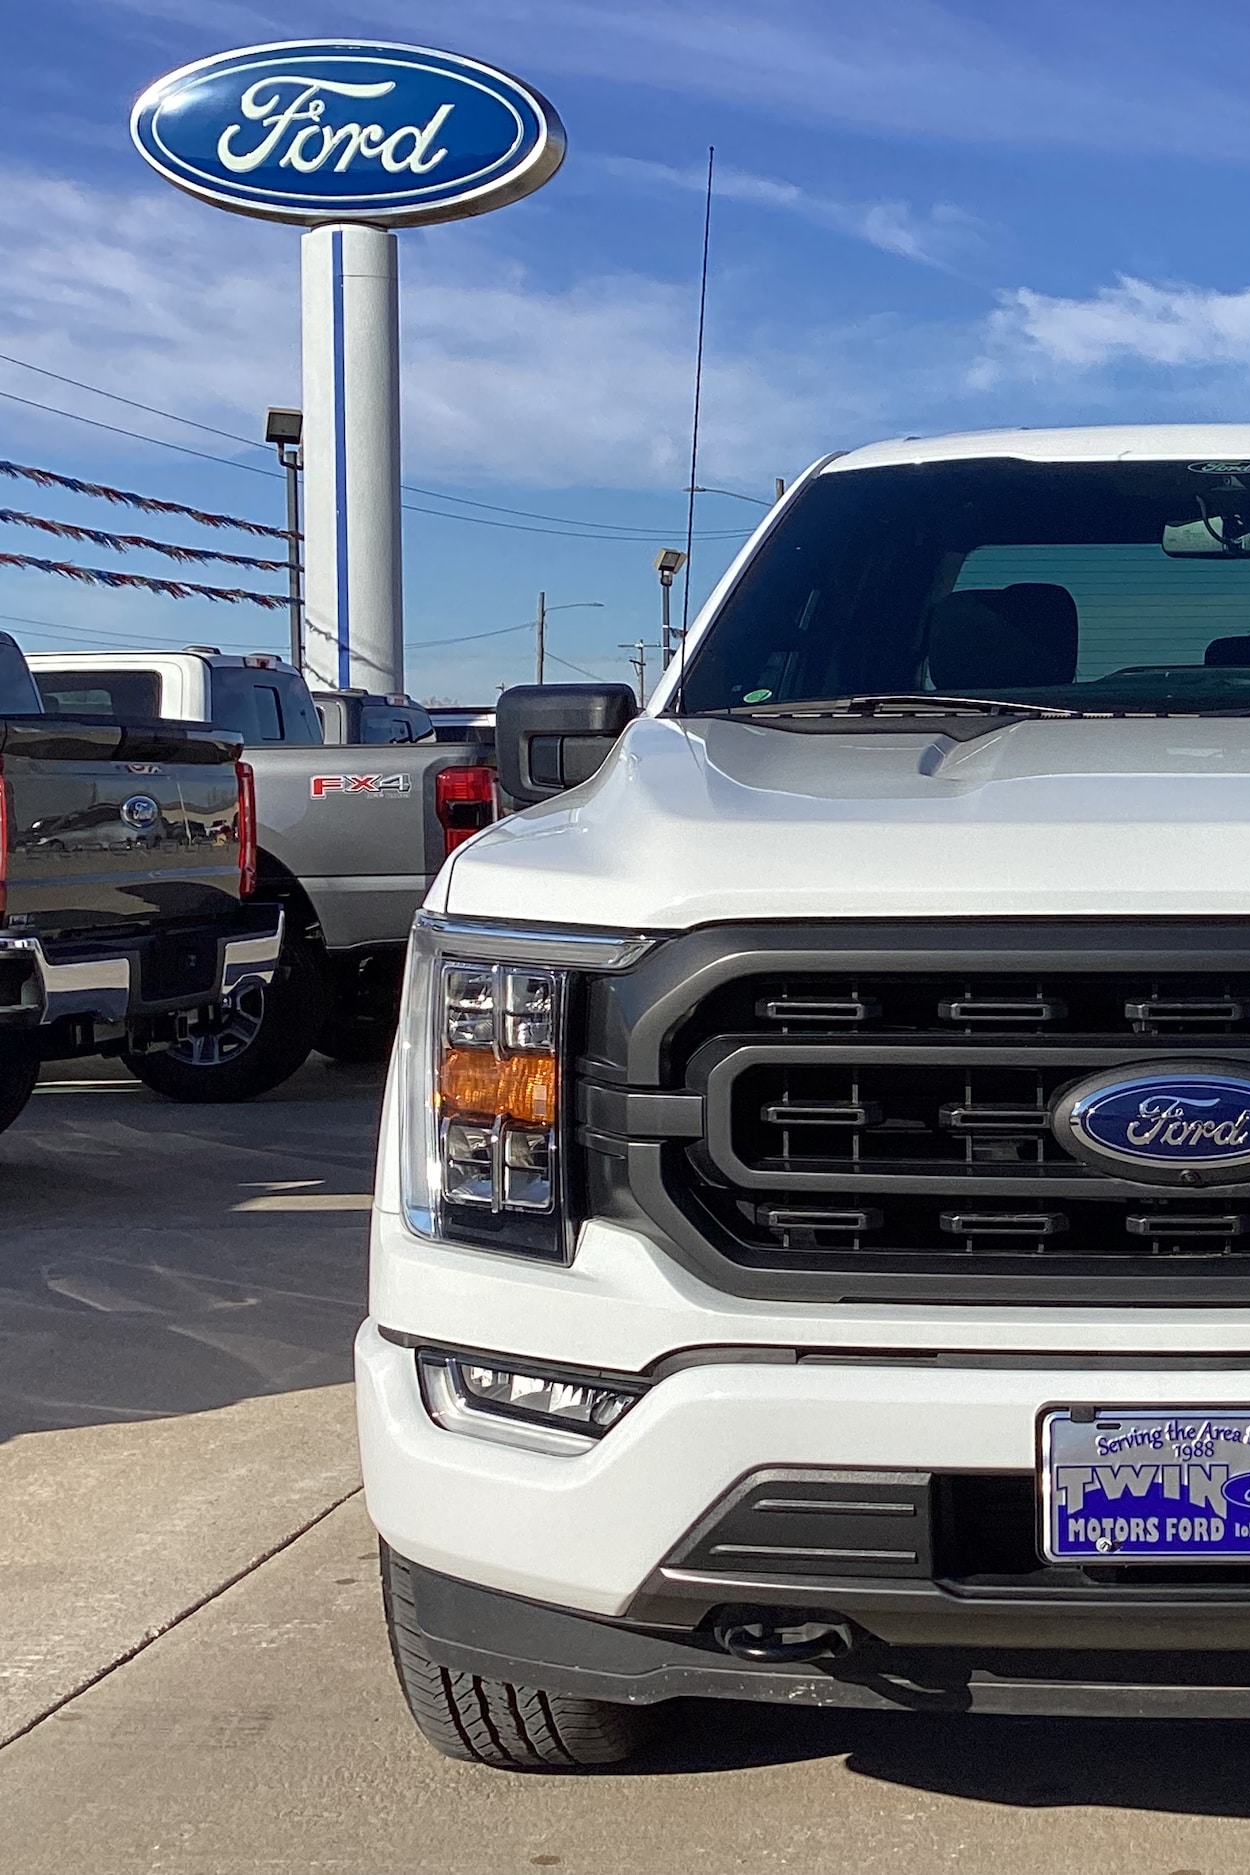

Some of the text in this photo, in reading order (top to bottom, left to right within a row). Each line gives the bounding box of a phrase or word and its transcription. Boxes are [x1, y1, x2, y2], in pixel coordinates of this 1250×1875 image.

[217, 75, 456, 174] Ford
[310, 774, 412, 799] FX4
[1097, 1428, 1163, 1456] Serving
[1165, 1419, 1196, 1441] the
[1199, 1420, 1242, 1443] Area
[1174, 1441, 1215, 1462] 1988
[1056, 1464, 1229, 1519] TWIN
[1068, 1517, 1225, 1543] MOTORS FORD
